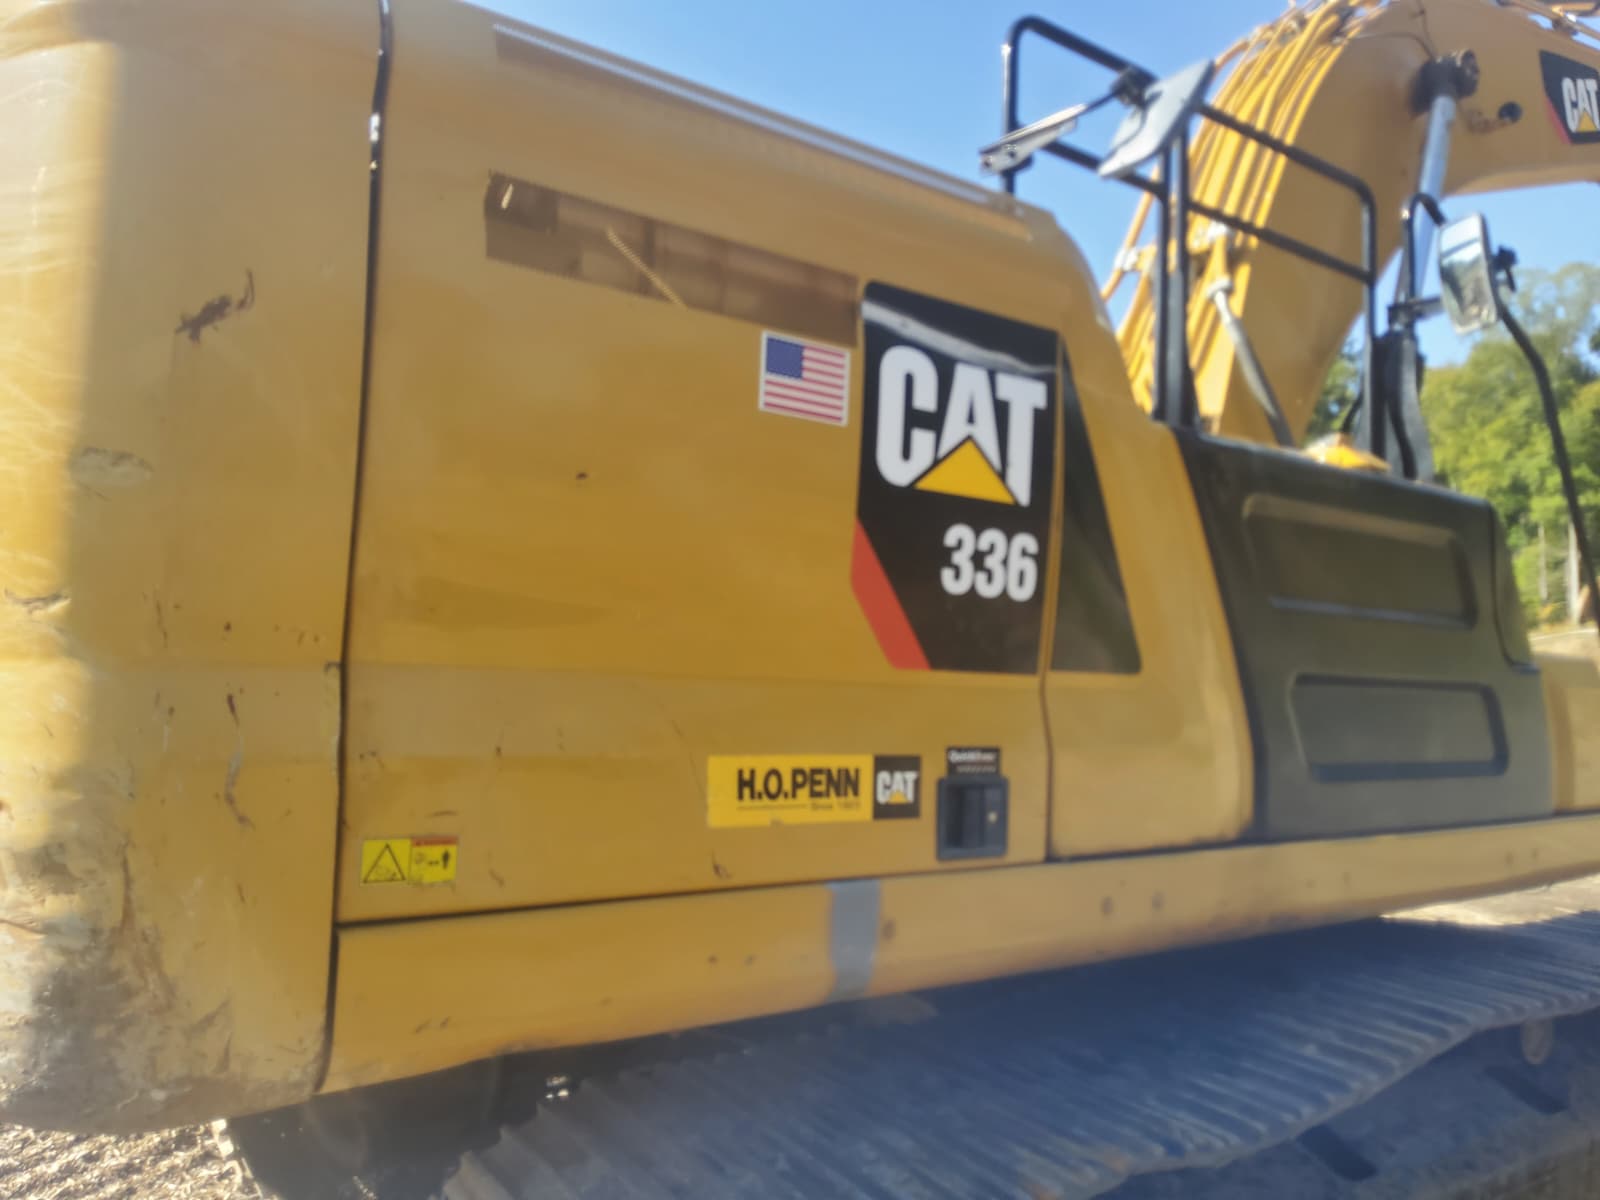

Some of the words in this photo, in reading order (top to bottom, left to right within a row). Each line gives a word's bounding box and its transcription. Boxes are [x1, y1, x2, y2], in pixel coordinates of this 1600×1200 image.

[1561, 77, 1600, 133] CAT
[875, 345, 1048, 507] CAT
[940, 523, 1039, 603] 336
[876, 770, 918, 804] CAT
